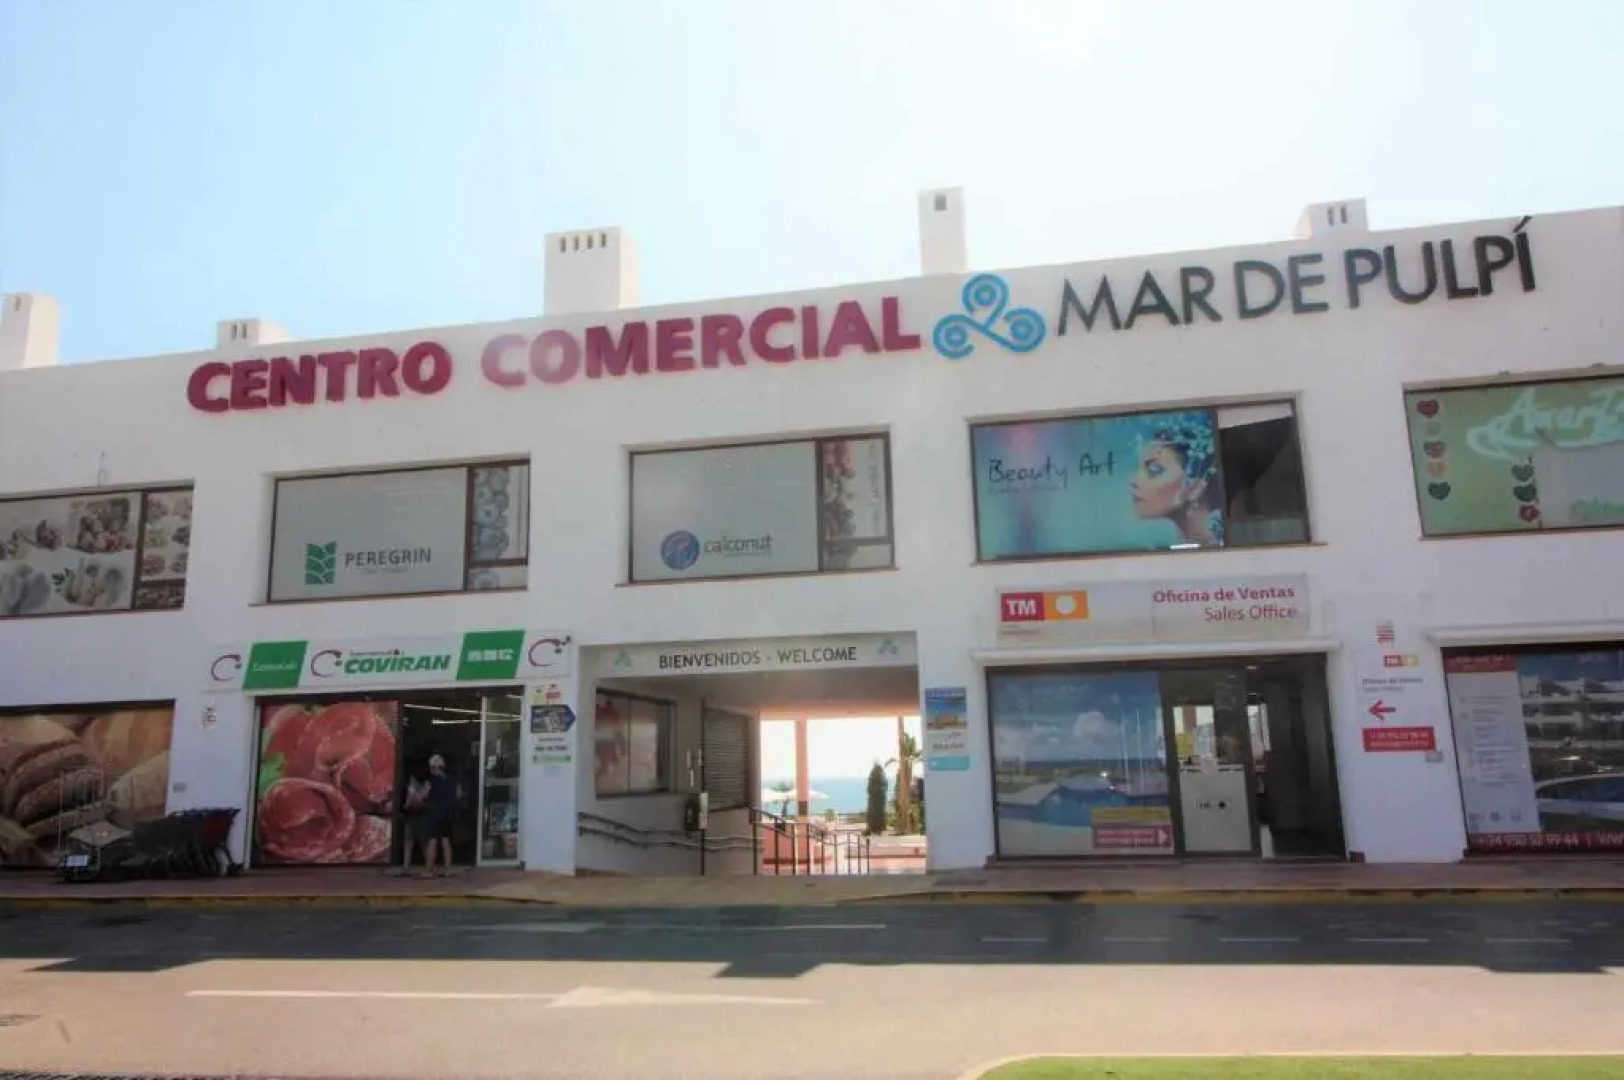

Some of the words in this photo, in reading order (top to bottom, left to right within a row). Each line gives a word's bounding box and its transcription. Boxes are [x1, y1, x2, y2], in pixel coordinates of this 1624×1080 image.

[1057, 264, 1223, 337] MAR
[1234, 252, 1328, 320] DE
[1344, 215, 1536, 309] PULPÍ
[187, 340, 453, 414] CENTRO
[481, 296, 921, 389] COMERCIAL
[988, 456, 1069, 489] Beauty
[1079, 452, 1117, 478] Art
[344, 548, 431, 567] PEREGRIN
[1153, 590, 1209, 604] Oficina
[1214, 587, 1234, 601] de
[1238, 586, 1295, 600] Ventas
[1006, 599, 1037, 616] TM
[1204, 606, 1244, 621] Sales
[1249, 604, 1297, 619] Office
[344, 655, 451, 674] COVIRAN
[659, 651, 761, 669] BIENVENIDOS
[777, 646, 857, 664] WELCOME
